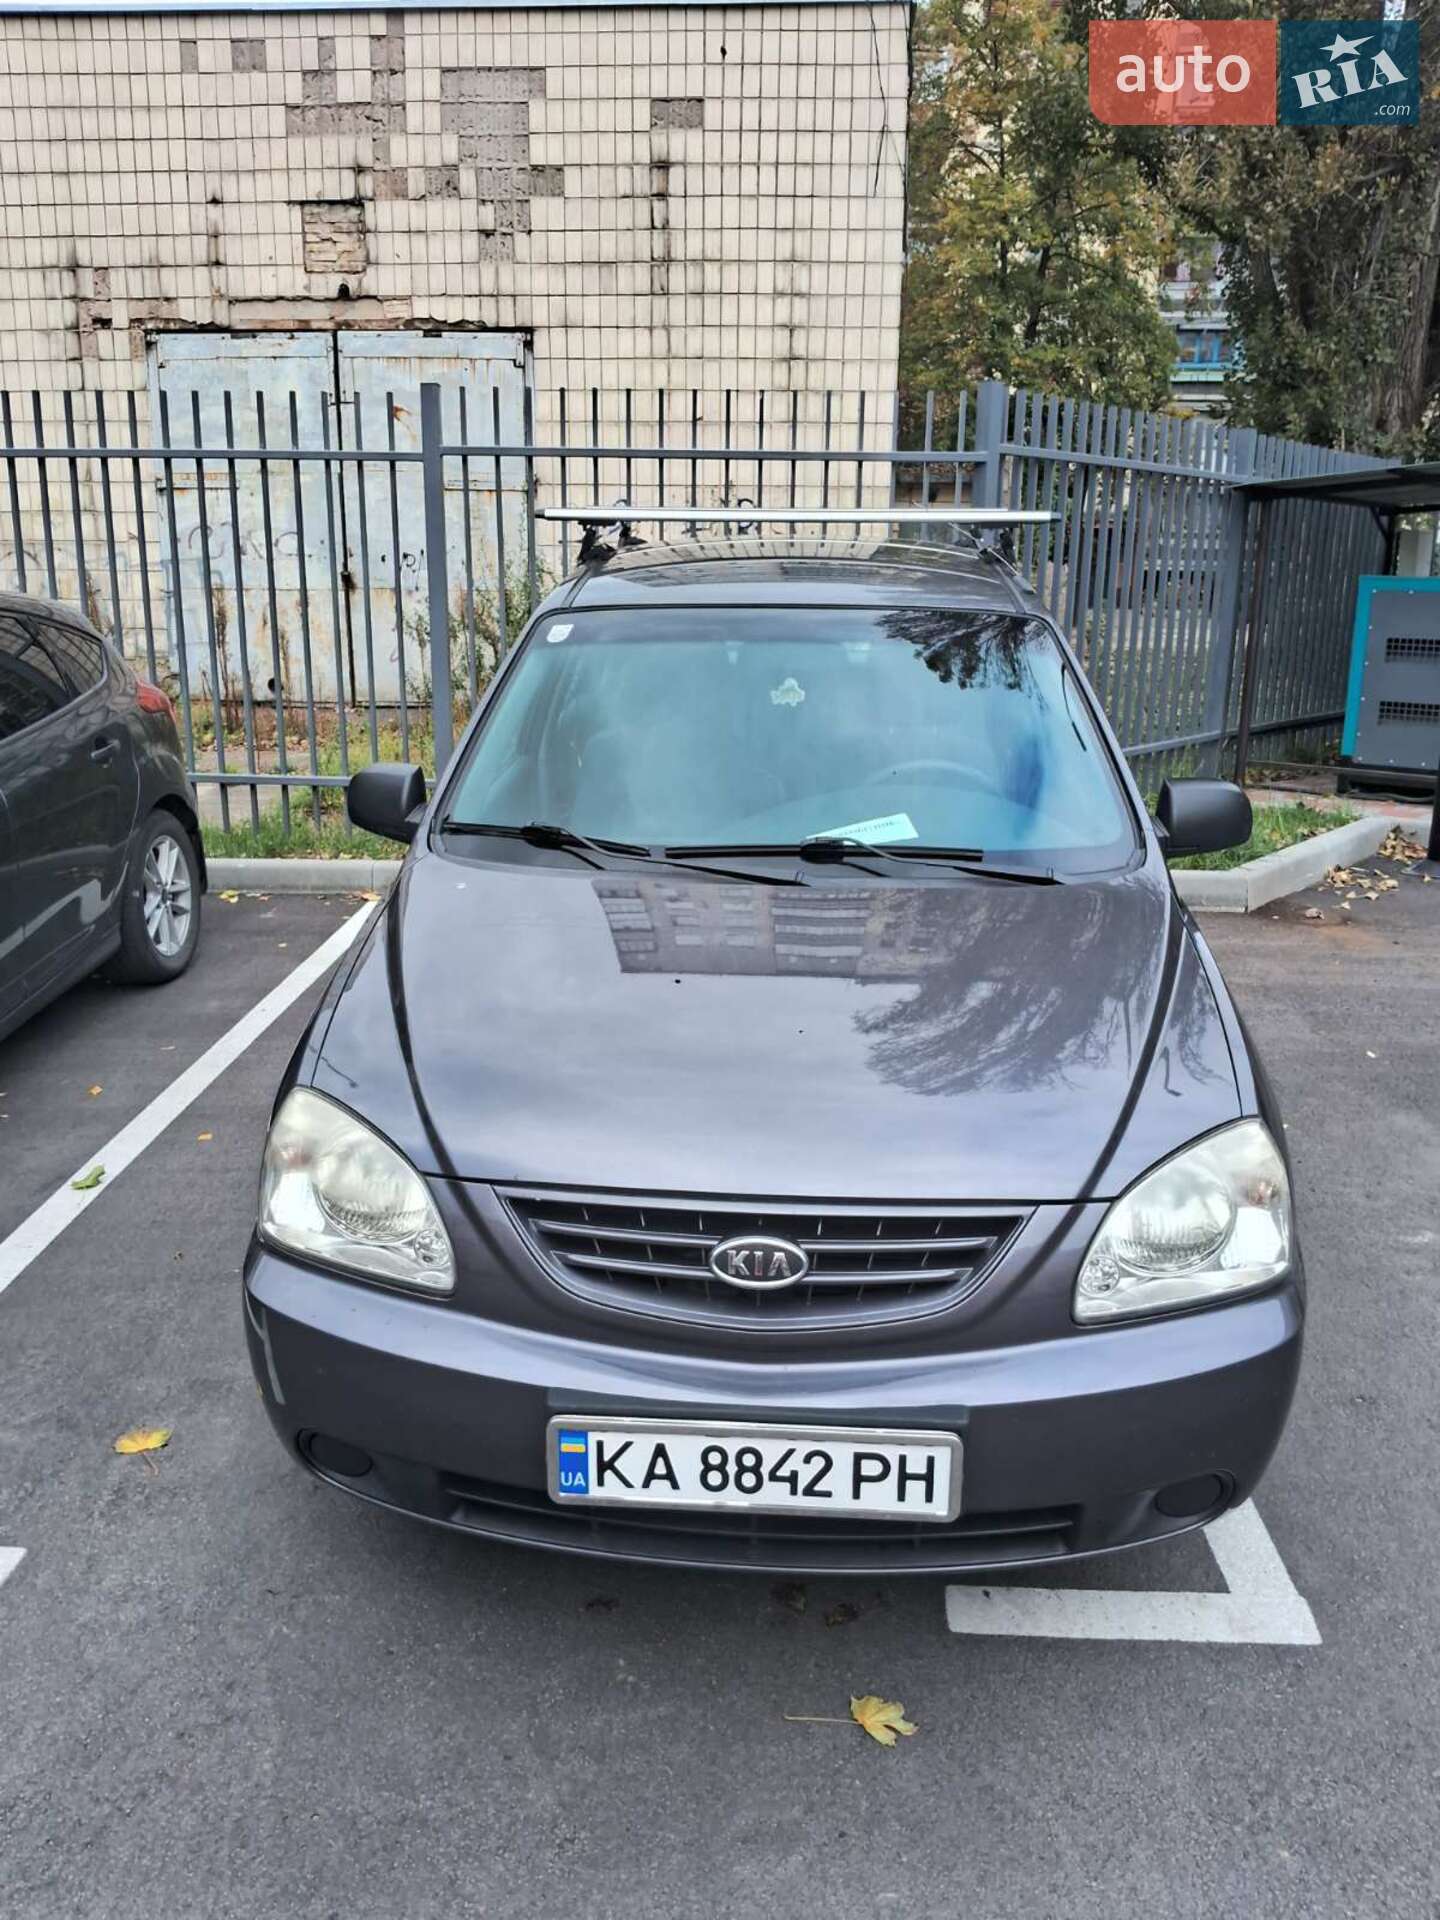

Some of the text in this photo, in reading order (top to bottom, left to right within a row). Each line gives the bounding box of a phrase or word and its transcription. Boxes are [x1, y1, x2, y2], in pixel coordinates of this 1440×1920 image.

[726, 1249, 792, 1277] KIA
[560, 1471, 586, 1487] UA
[596, 1439, 935, 1503] KA 8842 PH
